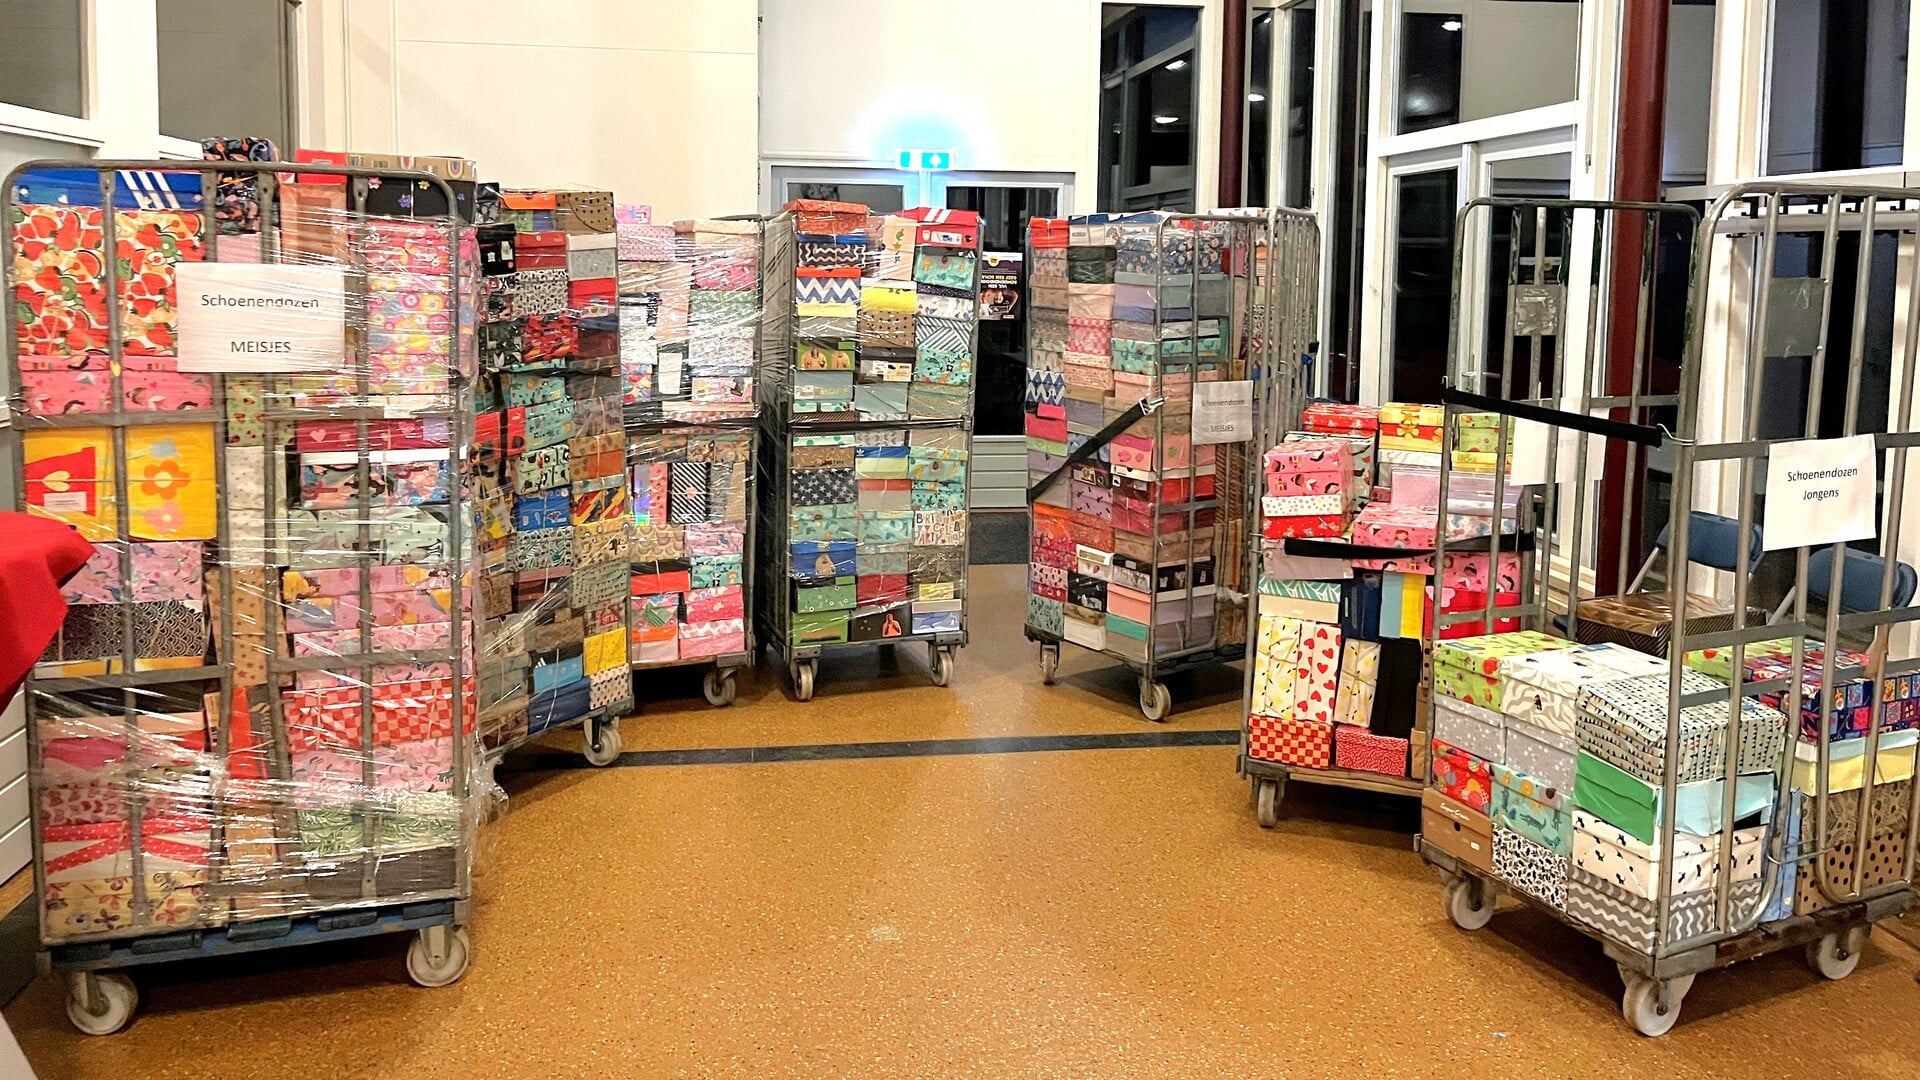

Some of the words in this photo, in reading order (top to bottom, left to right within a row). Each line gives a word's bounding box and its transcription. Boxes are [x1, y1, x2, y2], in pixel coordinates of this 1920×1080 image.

[200, 293, 319, 309] Schoenendozen
[230, 340, 292, 354] MEISJES
[1786, 466, 1859, 482] Schoenendozen
[1802, 488, 1841, 502] Jongens
